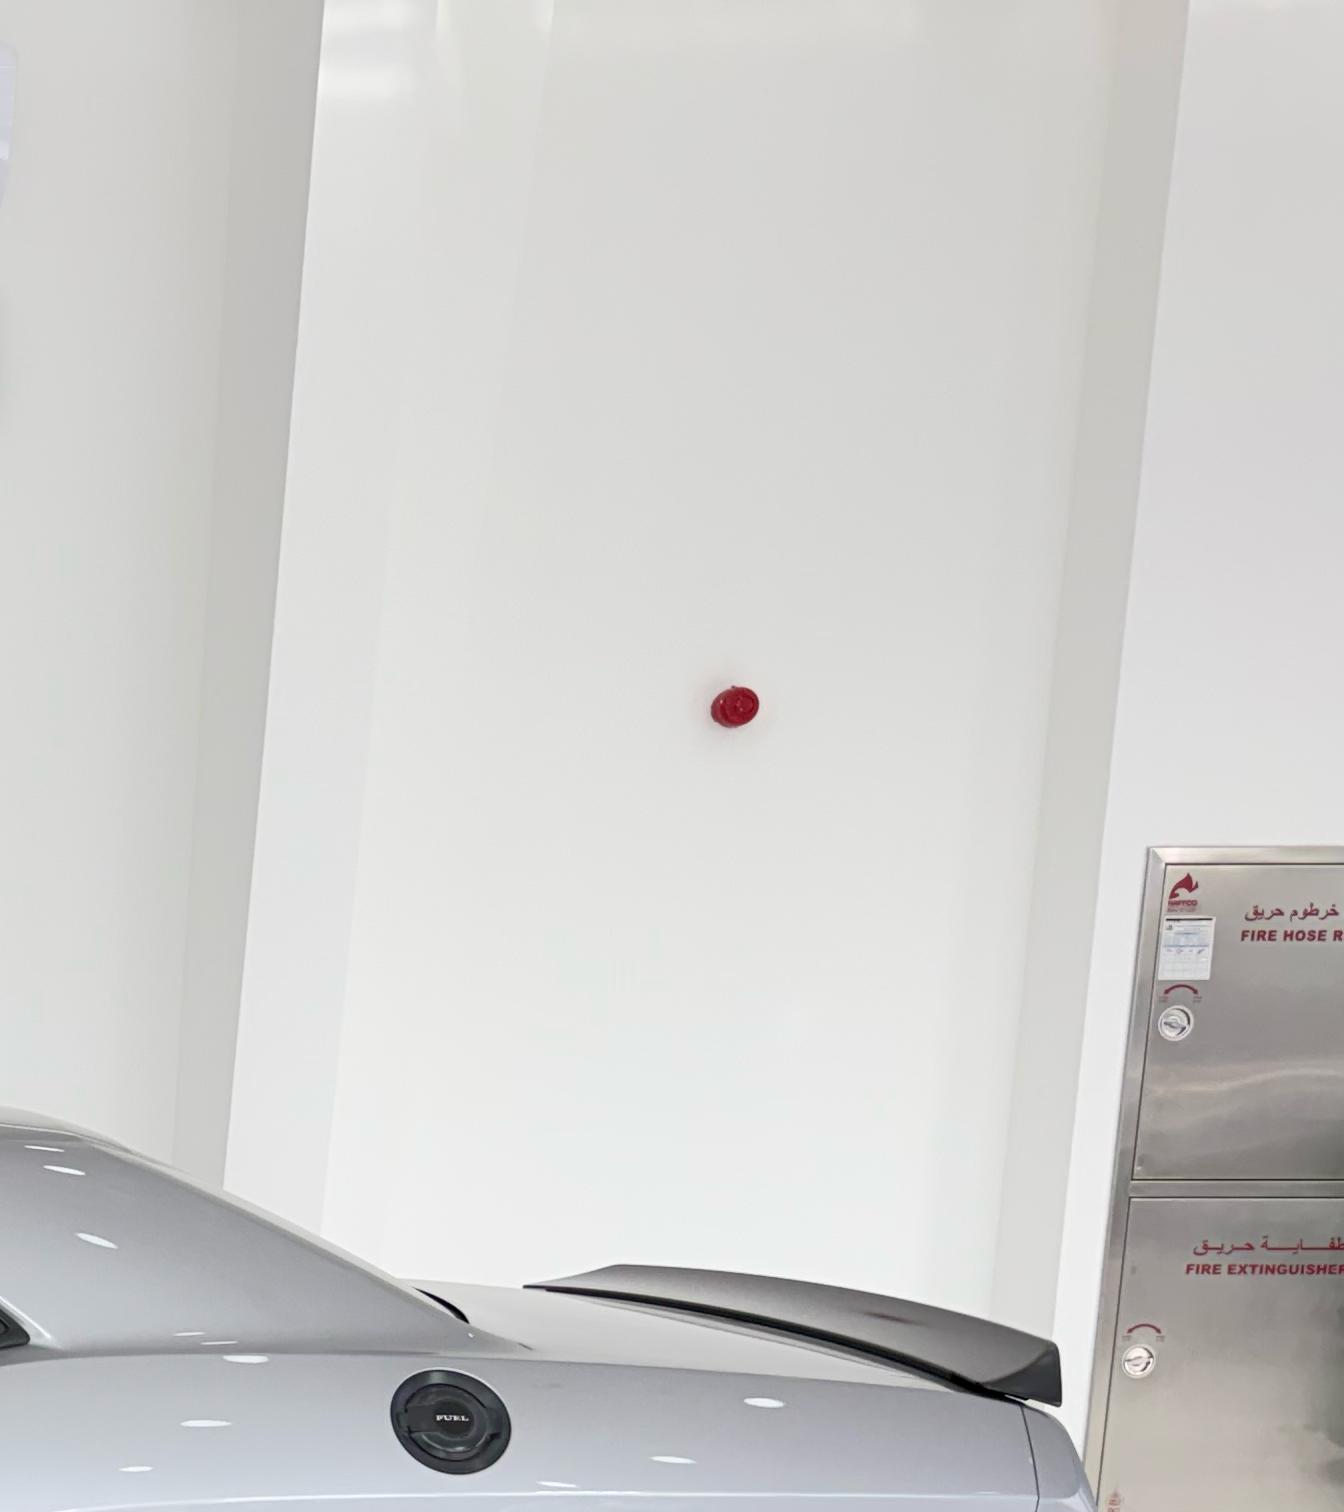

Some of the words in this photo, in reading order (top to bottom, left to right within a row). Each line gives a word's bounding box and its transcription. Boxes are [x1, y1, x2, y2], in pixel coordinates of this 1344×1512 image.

[1244, 904, 1285, 921] حريق
[1290, 902, 1340, 922] خرطوم
[1240, 929, 1278, 942] FIRE
[1282, 929, 1328, 942] HOSE
[1193, 1239, 1254, 1256] حريق
[1185, 1264, 1222, 1275] FIRE
[435, 1414, 469, 1422] FUEL
